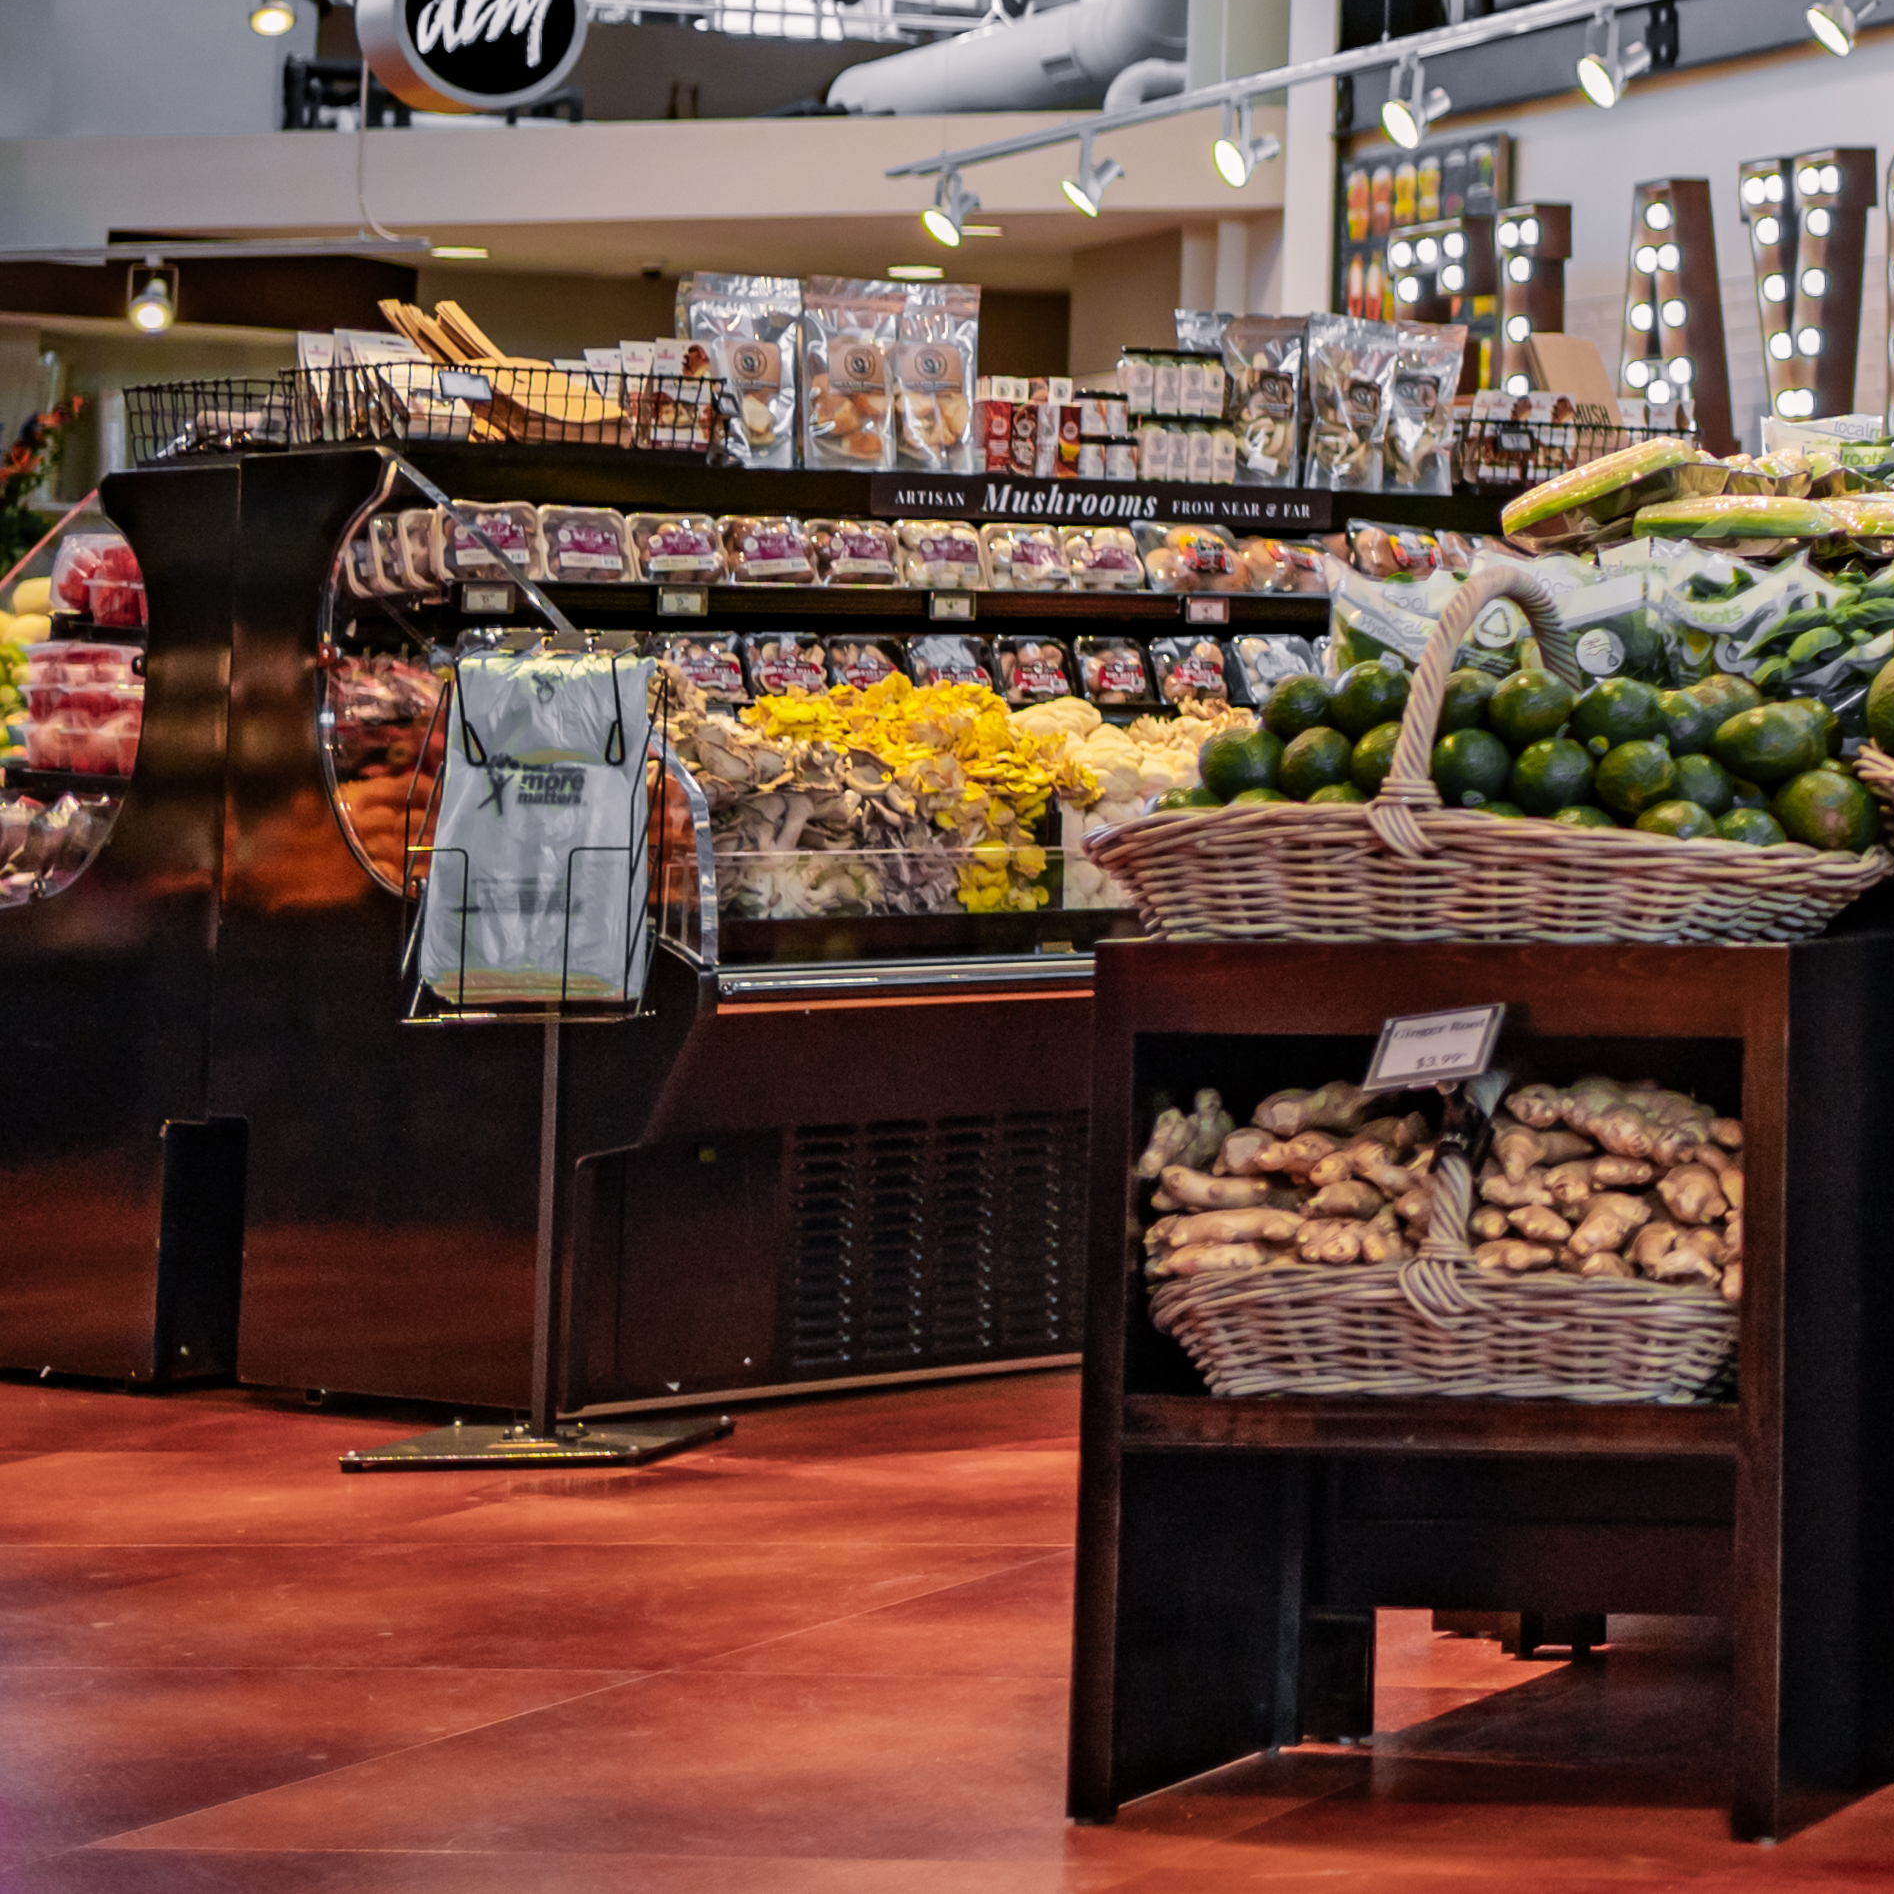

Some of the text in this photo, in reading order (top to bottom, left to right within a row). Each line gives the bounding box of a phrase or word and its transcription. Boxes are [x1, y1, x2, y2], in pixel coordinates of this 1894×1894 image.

[895, 483, 1311, 519] ARTISAN Mushrooms FROM NEAR & FAR
[521, 773, 585, 792] more
[518, 791, 581, 805] matters
[1393, 1018, 1486, 1040] Ginger Root
[1415, 1053, 1461, 1070] $3.99
